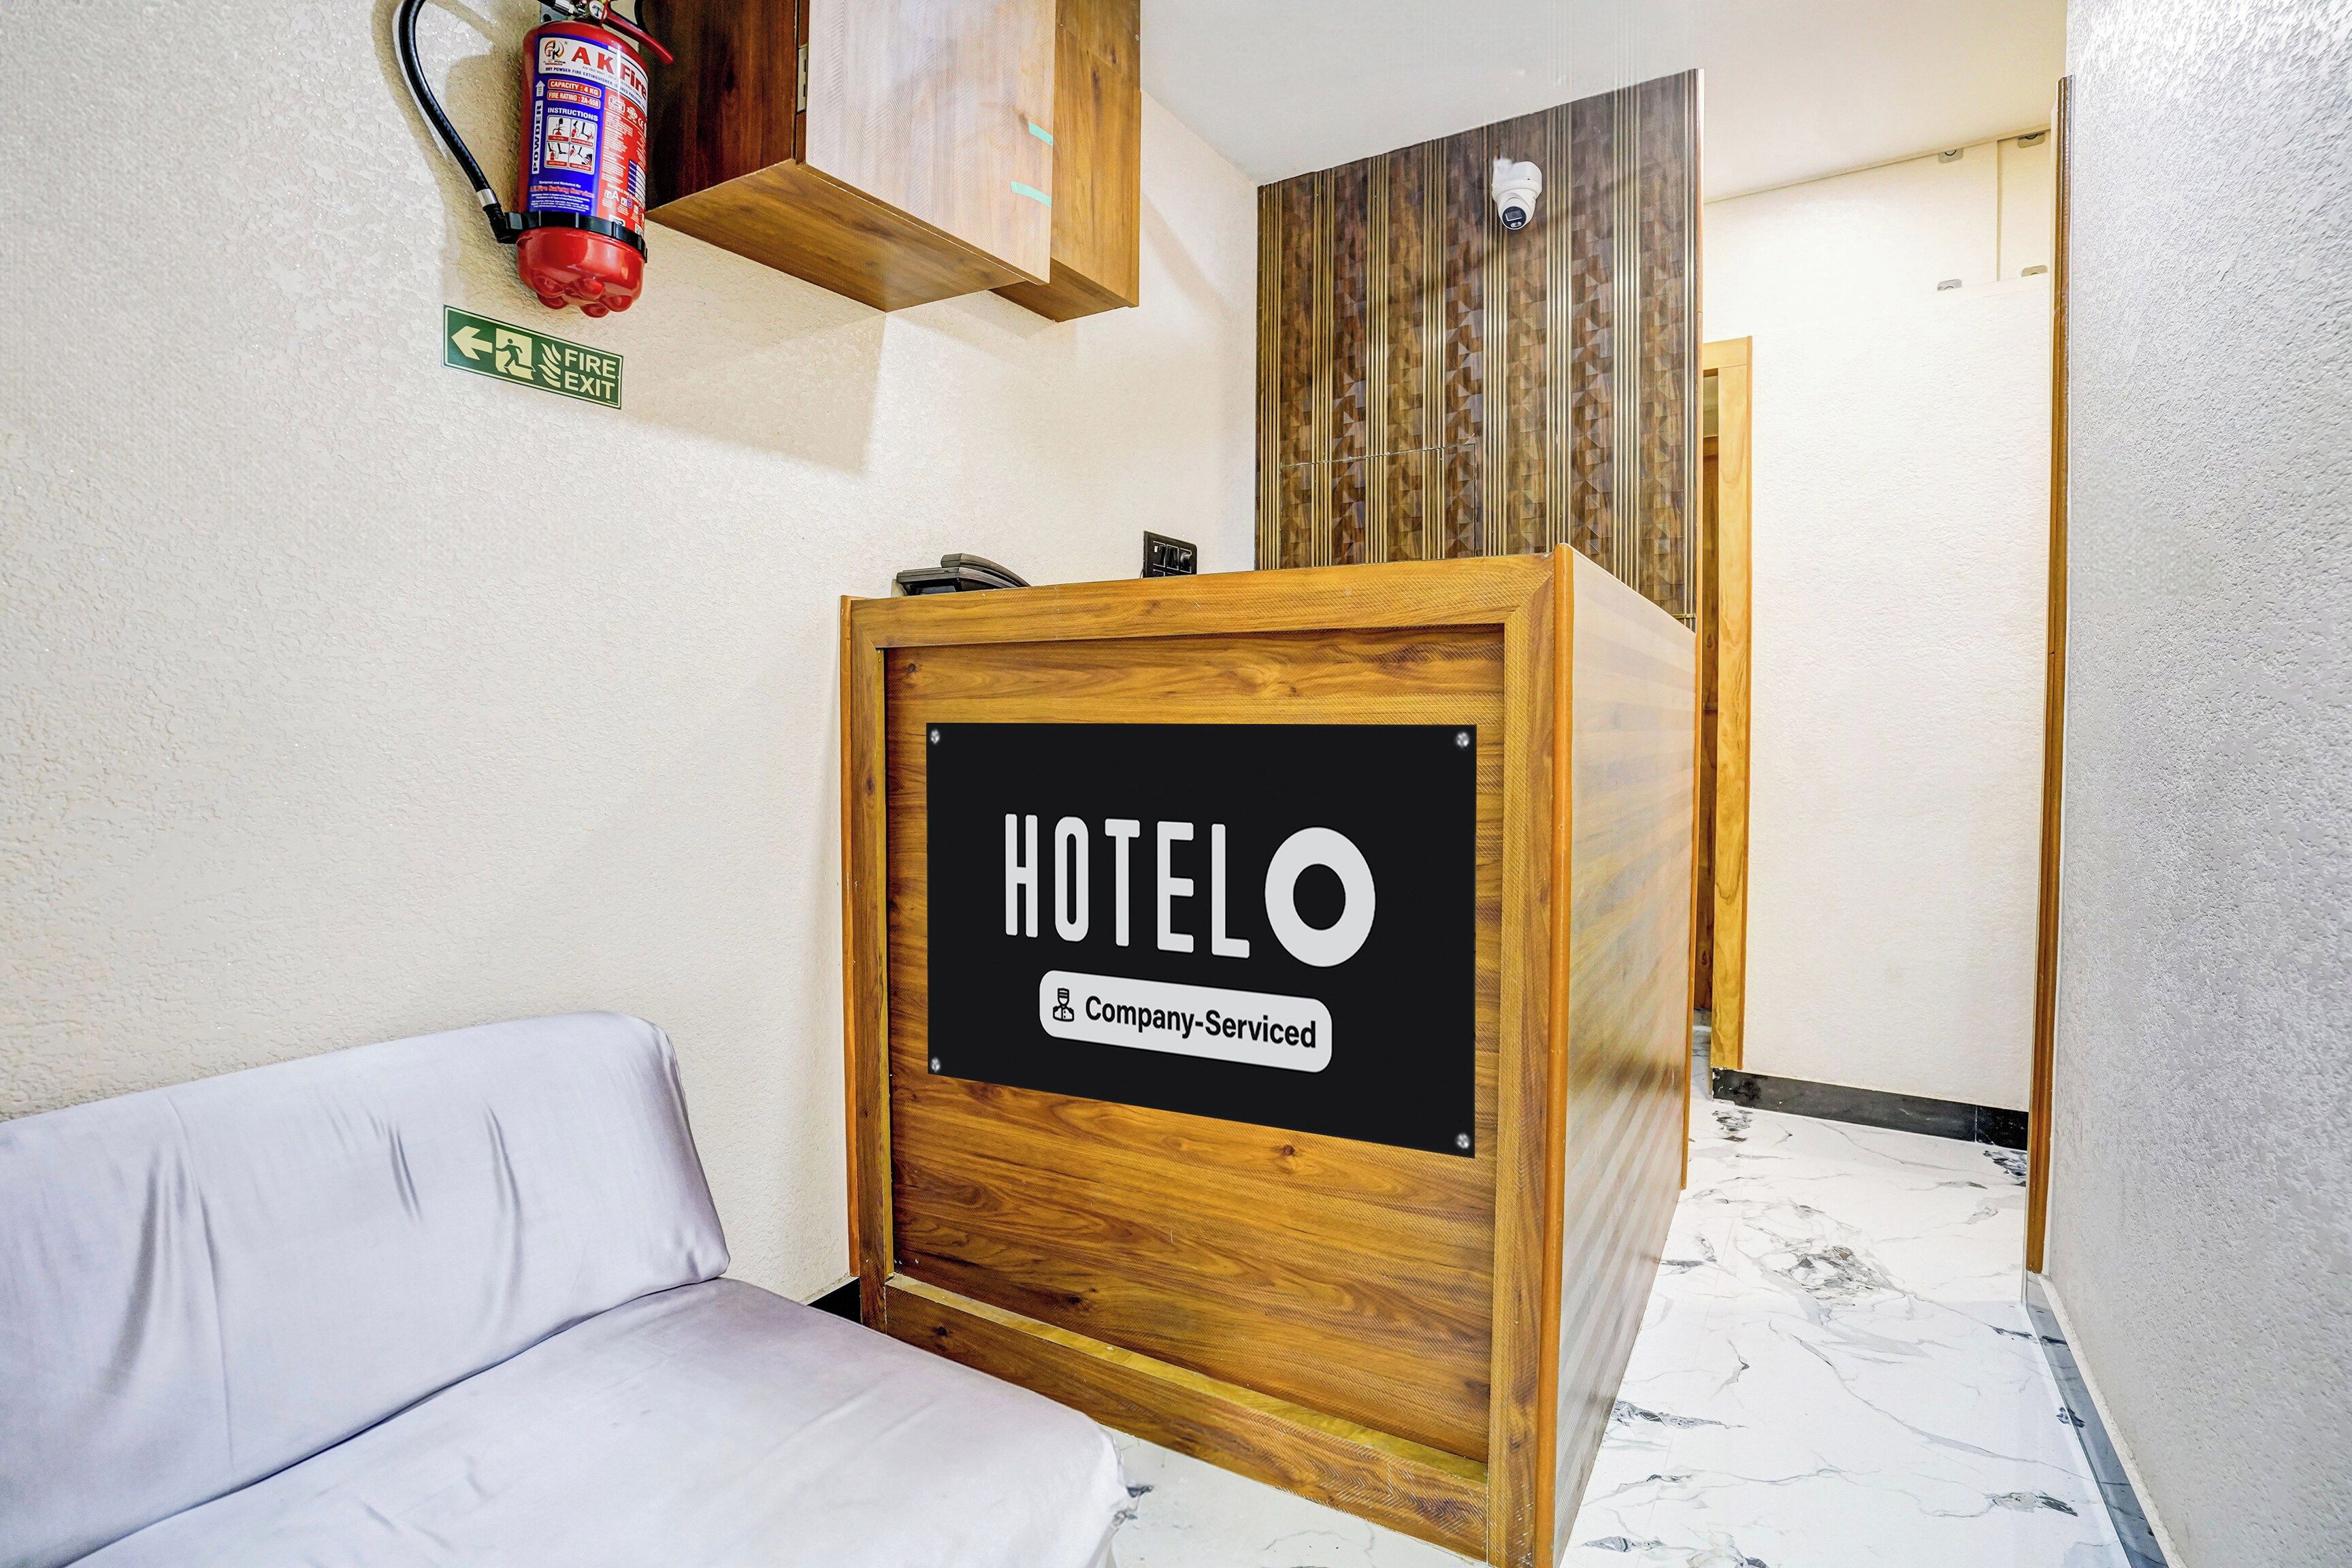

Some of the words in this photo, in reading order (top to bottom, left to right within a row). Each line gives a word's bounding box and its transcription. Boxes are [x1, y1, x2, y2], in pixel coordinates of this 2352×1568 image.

[571, 46, 591, 66] A
[597, 52, 614, 75] K
[620, 63, 647, 101] Fire
[583, 71, 613, 85] EXTINGUISHER
[550, 81, 579, 90] CAPACITY
[589, 87, 598, 96] KG
[559, 93, 578, 101] RATING
[547, 107, 598, 122] INSTRUCTIONS
[533, 105, 542, 172] POWDER
[565, 348, 617, 379] FIRE
[565, 371, 615, 399] EXIT
[1005, 813, 1250, 959] HOTEL
[1264, 827, 1376, 968] O
[1085, 995, 1317, 1049] Company-Serviced
